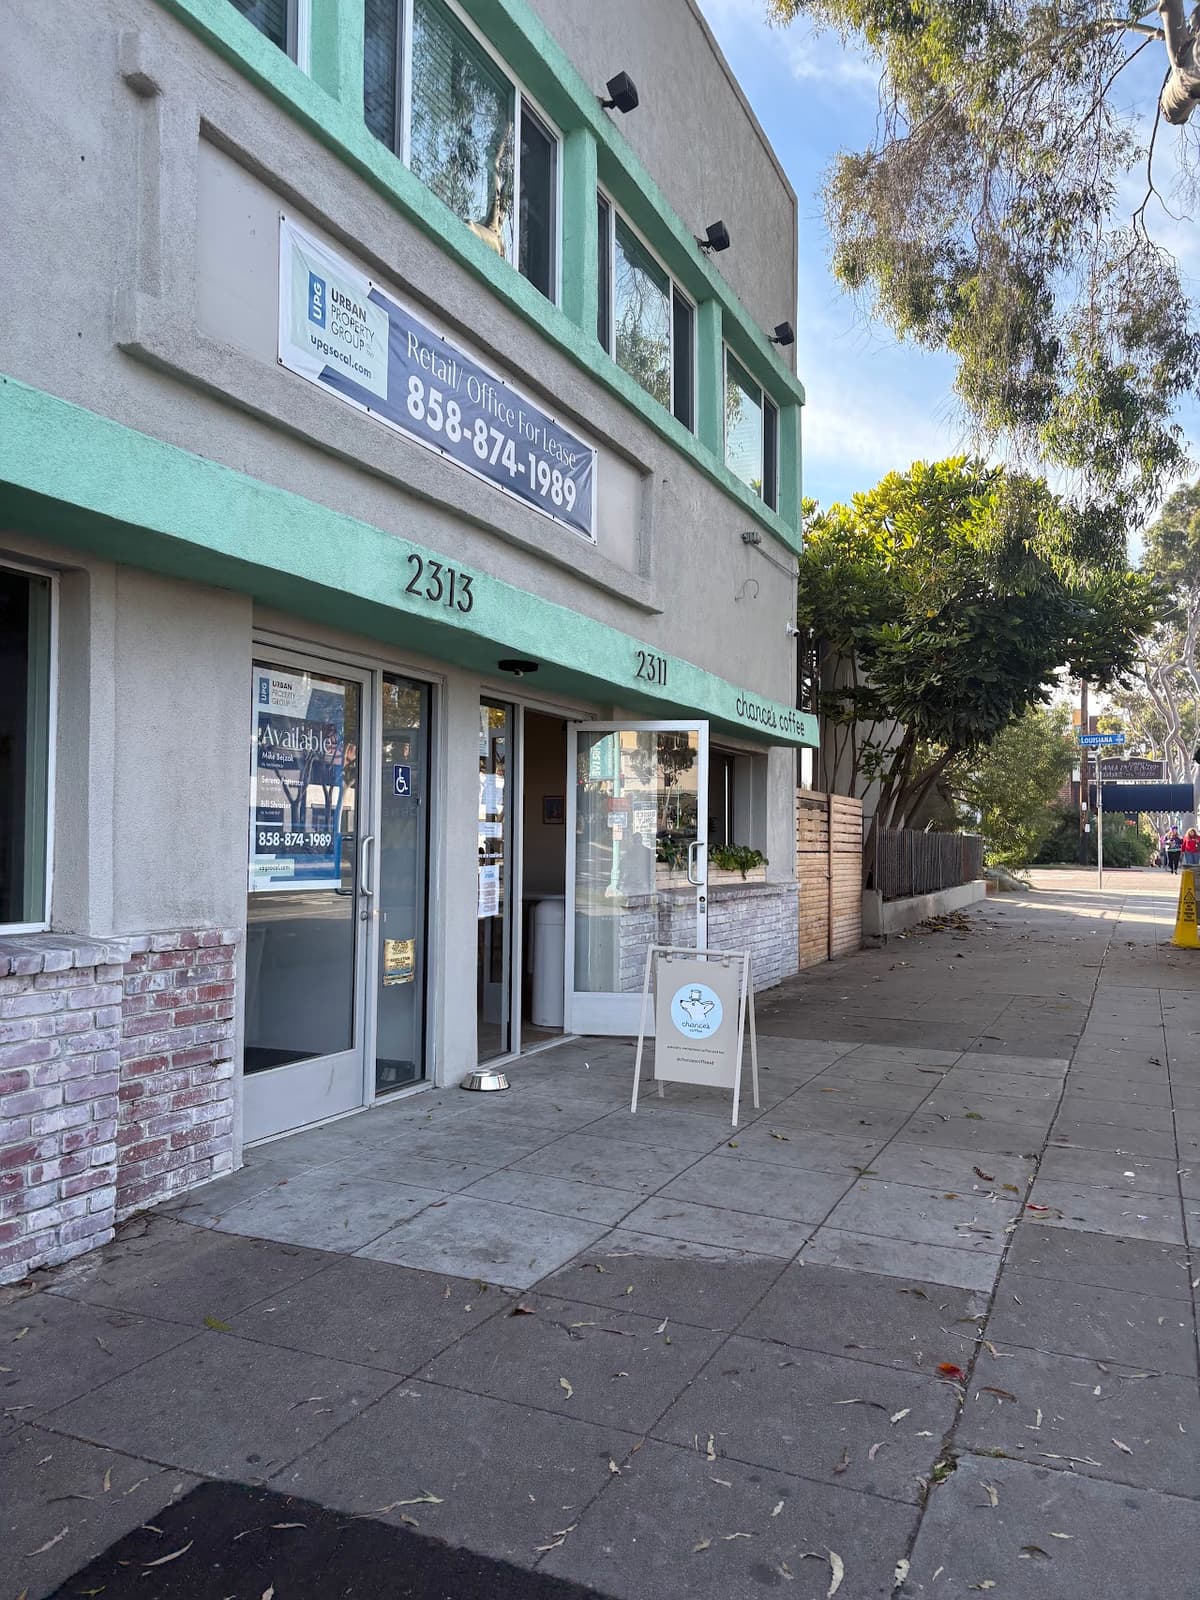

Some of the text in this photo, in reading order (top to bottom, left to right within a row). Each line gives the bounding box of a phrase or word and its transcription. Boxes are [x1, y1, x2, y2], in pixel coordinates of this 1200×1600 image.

[313, 281, 322, 320] UPG
[331, 287, 367, 323] URBAN
[331, 304, 375, 343] PROPERTY
[331, 321, 365, 350] GROUP
[310, 334, 372, 379] upgsocal.com
[467, 375, 515, 428] Office
[519, 410, 540, 444] For
[543, 427, 576, 470] Lease
[407, 375, 576, 512] 858-874-1989
[405, 553, 474, 613] 2313
[635, 650, 667, 686] 2311
[736, 692, 805, 736] chance's coffee
[261, 723, 334, 756] Available
[1080, 736, 1113, 744] LOUISIANA
[258, 831, 332, 847] 858-874-1989
